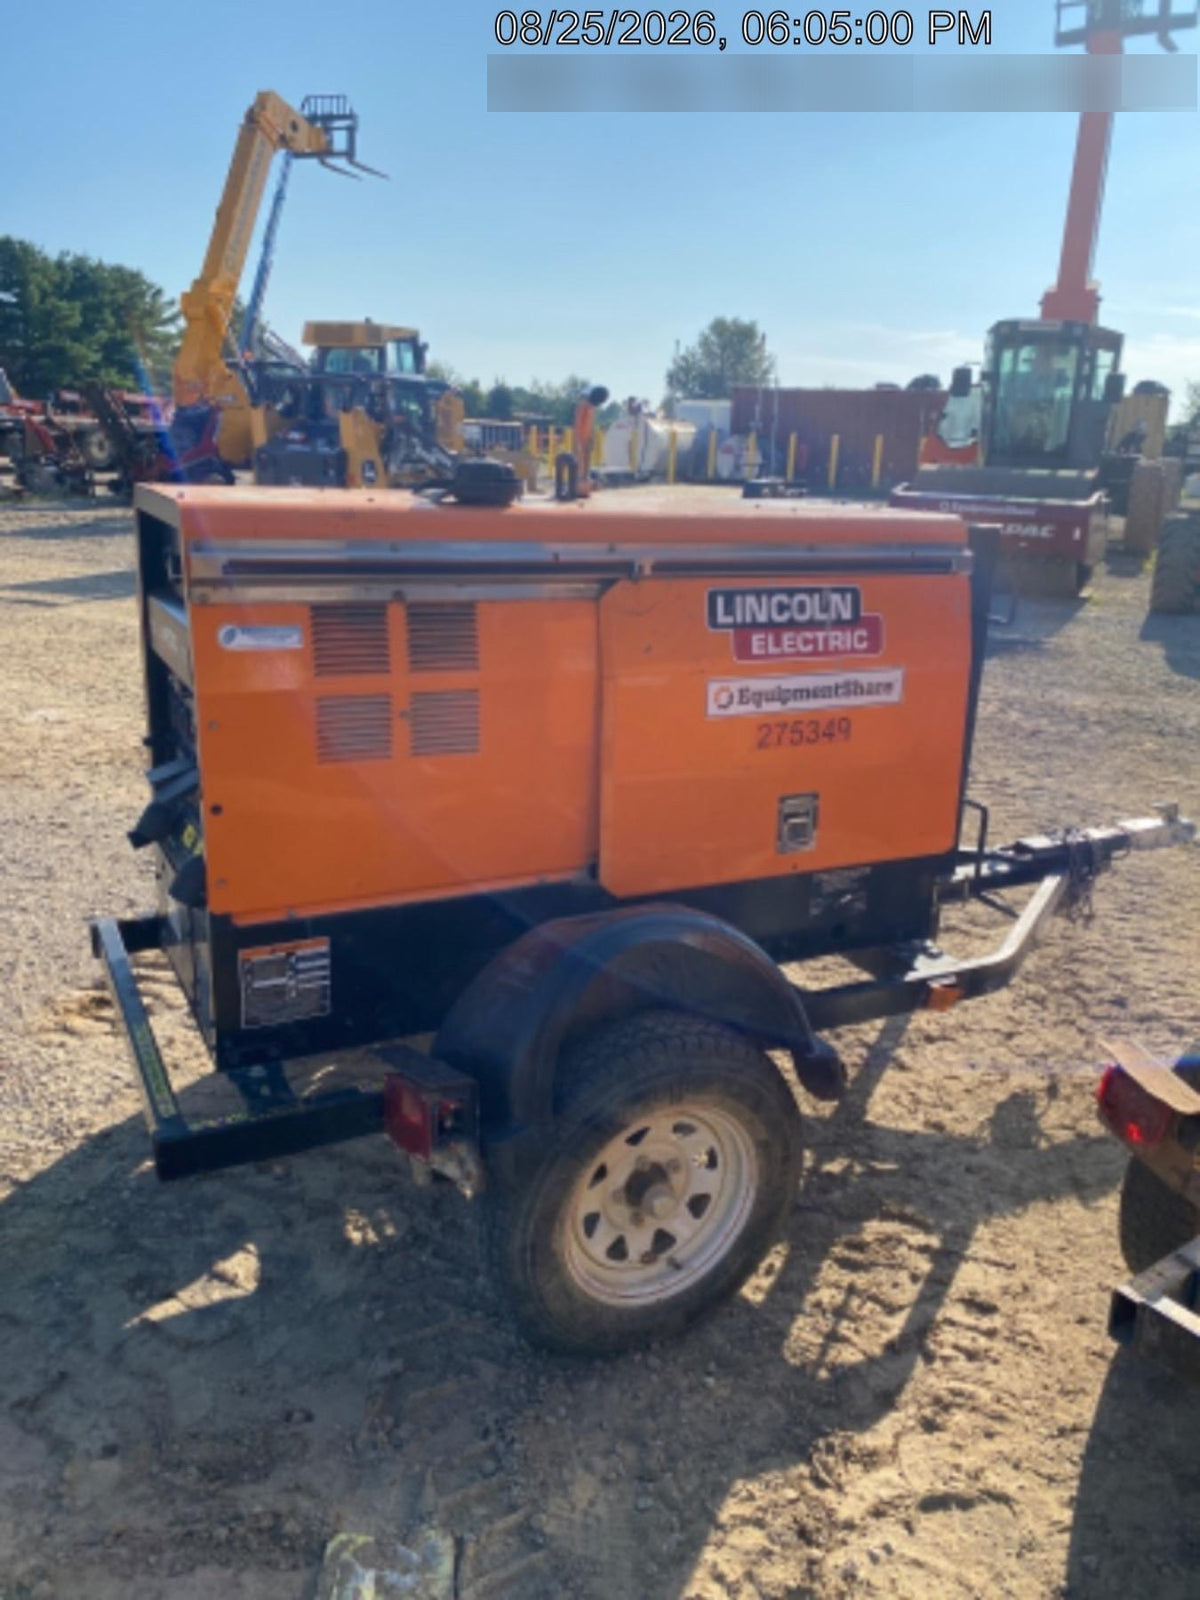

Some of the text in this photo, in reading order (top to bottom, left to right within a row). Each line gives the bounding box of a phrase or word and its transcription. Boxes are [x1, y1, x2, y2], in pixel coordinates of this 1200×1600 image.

[716, 593, 853, 624] LINCOLN
[751, 629, 869, 655] ELECTRIC
[737, 679, 895, 708] EquipmentShare
[757, 716, 851, 749] 275349
